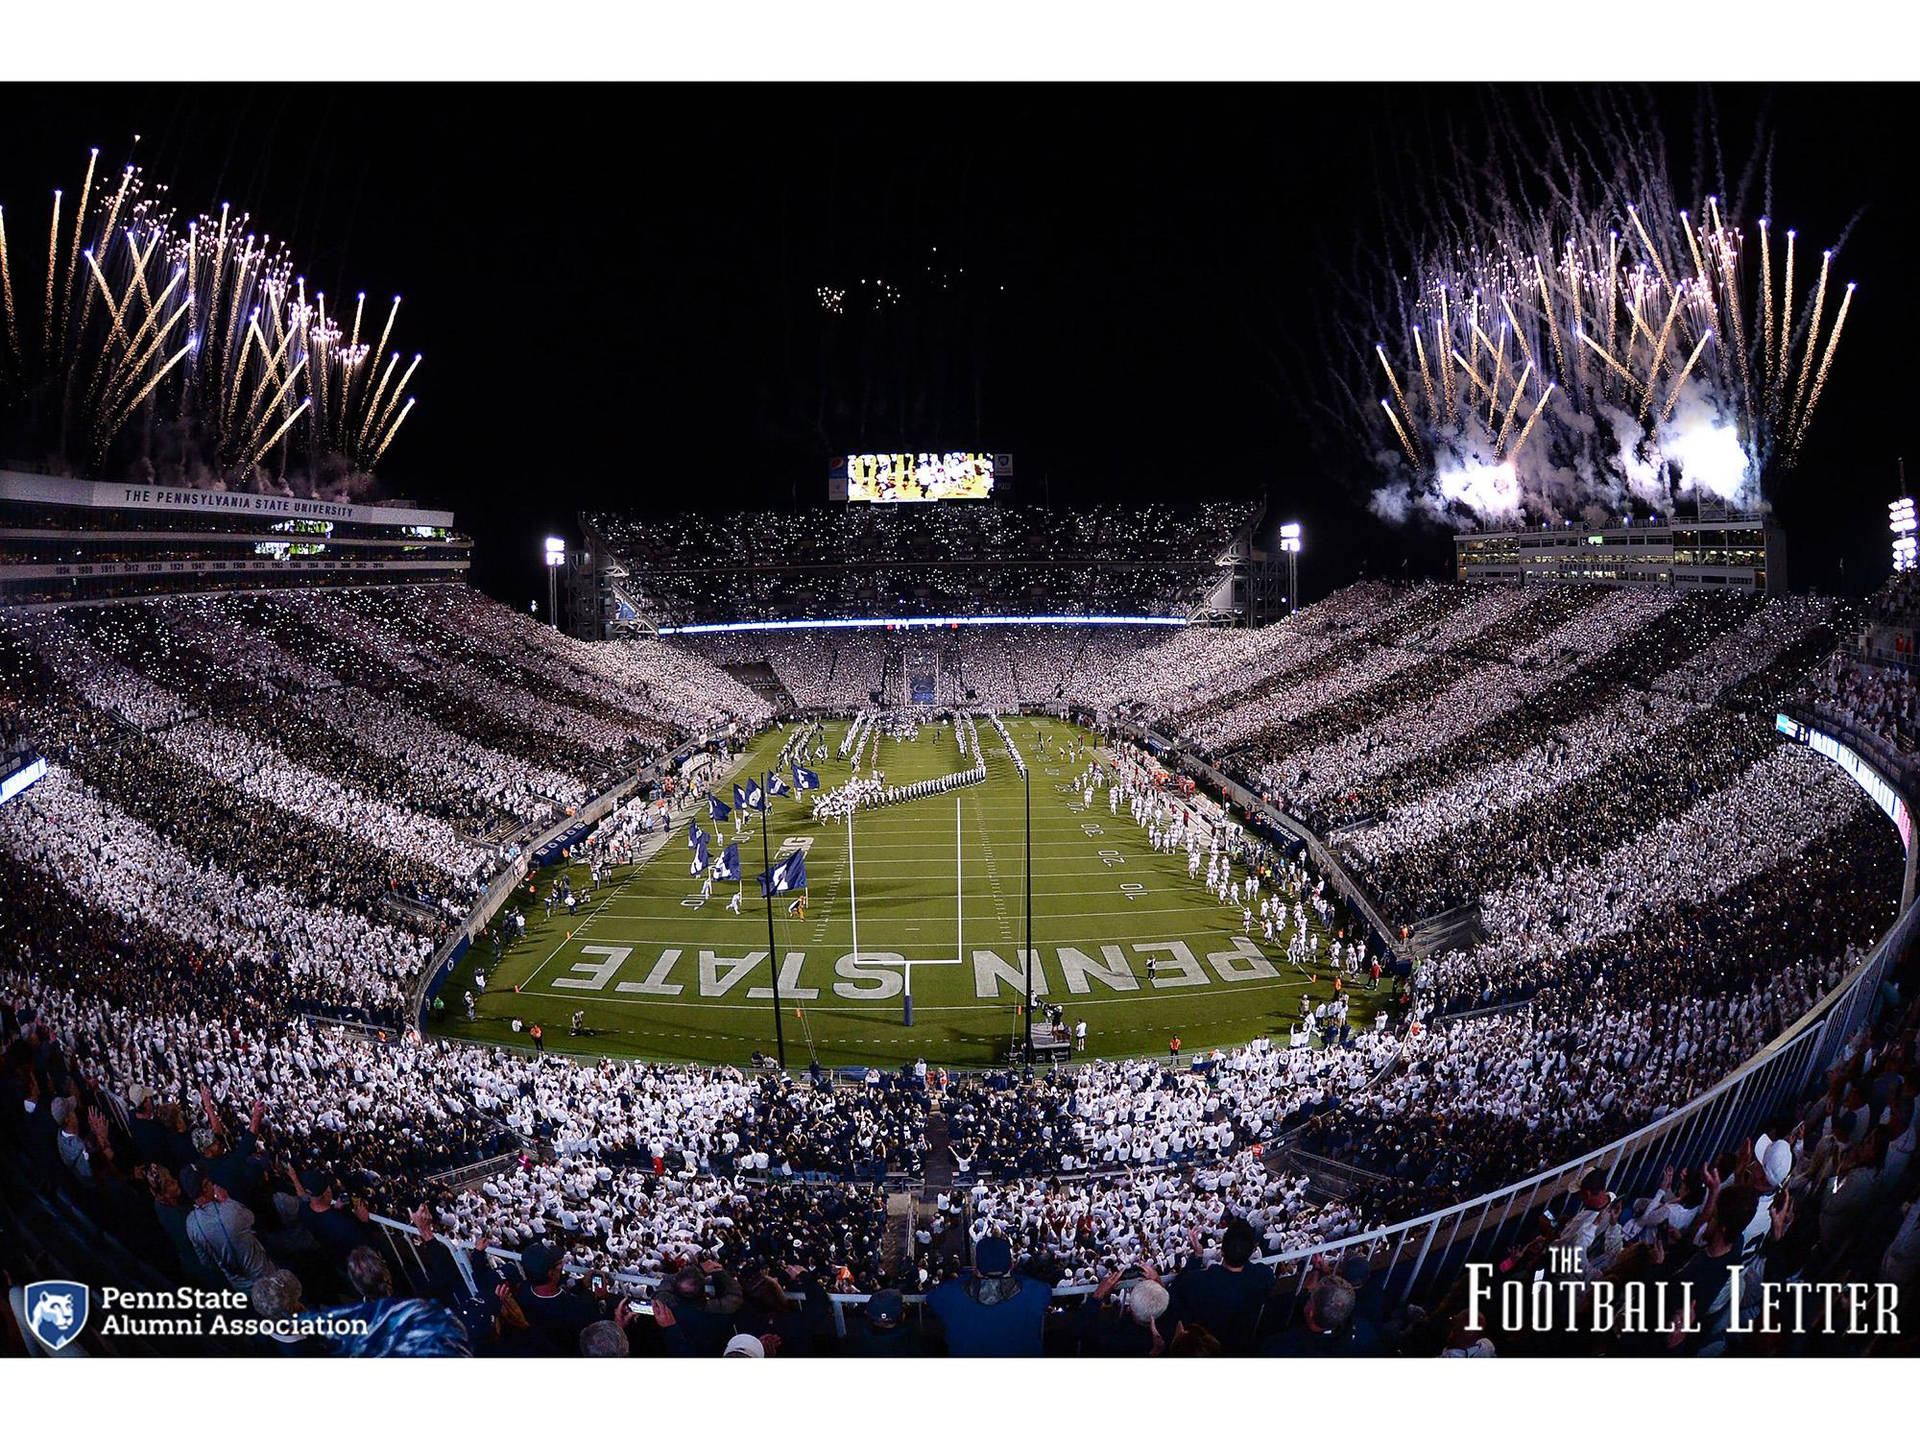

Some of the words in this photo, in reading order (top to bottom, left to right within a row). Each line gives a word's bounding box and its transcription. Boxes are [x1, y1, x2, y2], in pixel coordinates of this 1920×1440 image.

[125, 489, 151, 502] THE
[156, 491, 250, 509] PENNSYLVANIA
[255, 498, 290, 511] STATE
[294, 502, 353, 517] UNIVERSITY
[1097, 850, 1125, 865] 20
[1119, 883, 1149, 896] 10
[551, 945, 904, 999] STATE
[972, 936, 1280, 998] PENN
